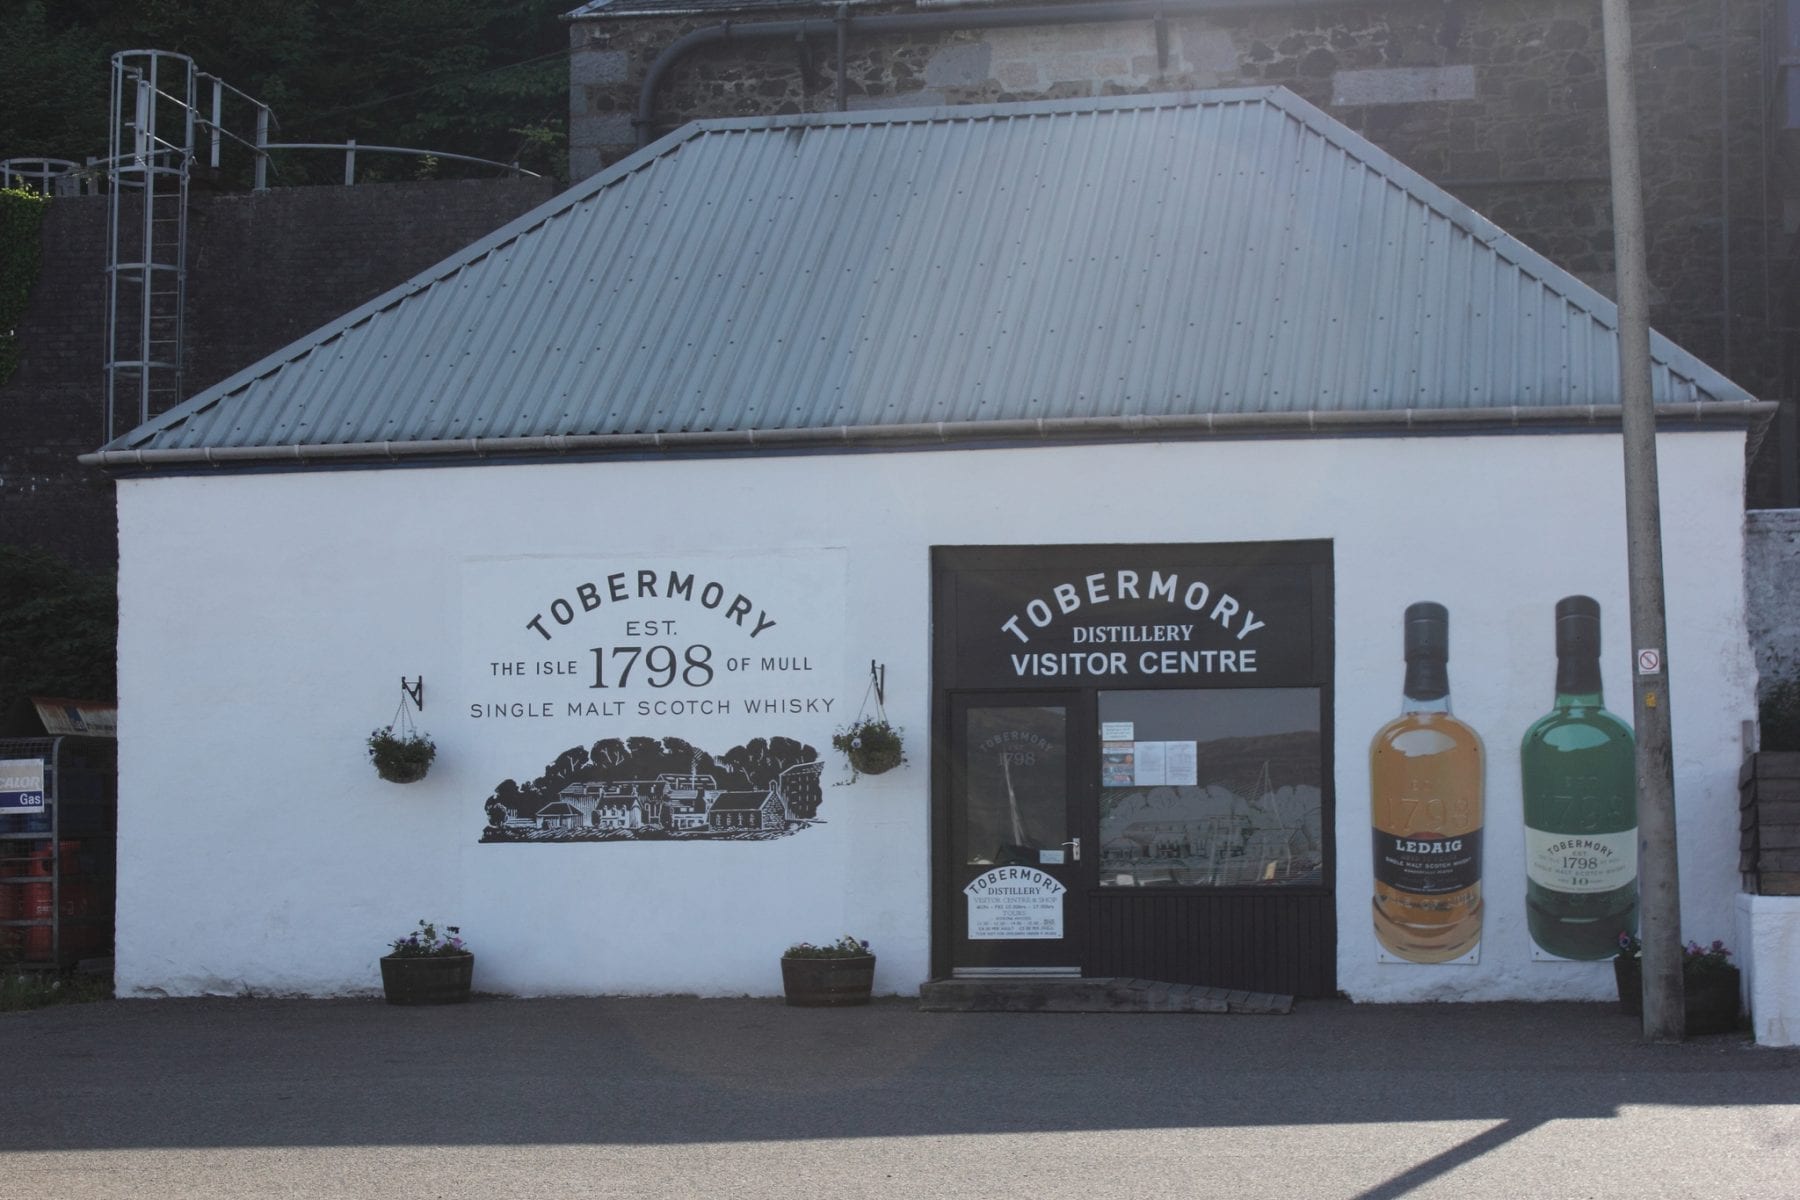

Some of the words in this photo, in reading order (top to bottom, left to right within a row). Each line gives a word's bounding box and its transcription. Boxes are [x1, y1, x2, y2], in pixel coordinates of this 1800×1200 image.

[526, 569, 777, 641] TOBERMORY
[1001, 570, 1265, 644] TOBERMORY
[626, 620, 678, 636] EST.
[1073, 624, 1194, 643] DISTILLERY
[490, 661, 525, 676] THE
[536, 660, 578, 675] ISLE
[589, 644, 714, 689] 1798
[726, 657, 751, 672] OF
[761, 656, 813, 671] MULL
[1010, 652, 1128, 676] VISITOR
[1139, 650, 1257, 674] CENTRE
[470, 702, 554, 718] SINGLE
[567, 701, 626, 716] MALT
[638, 700, 730, 716] SCOTCH
[744, 698, 836, 714] WHISKY
[20, 793, 41, 805] Gas
[1395, 839, 1462, 854] LEDAIG
[1547, 839, 1613, 857] TOBERMORY
[1563, 857, 1598, 869] 1798
[969, 868, 1061, 895] TOBERMORY
[1572, 877, 1589, 886] 10
[988, 887, 1041, 895] DISTILLERY
